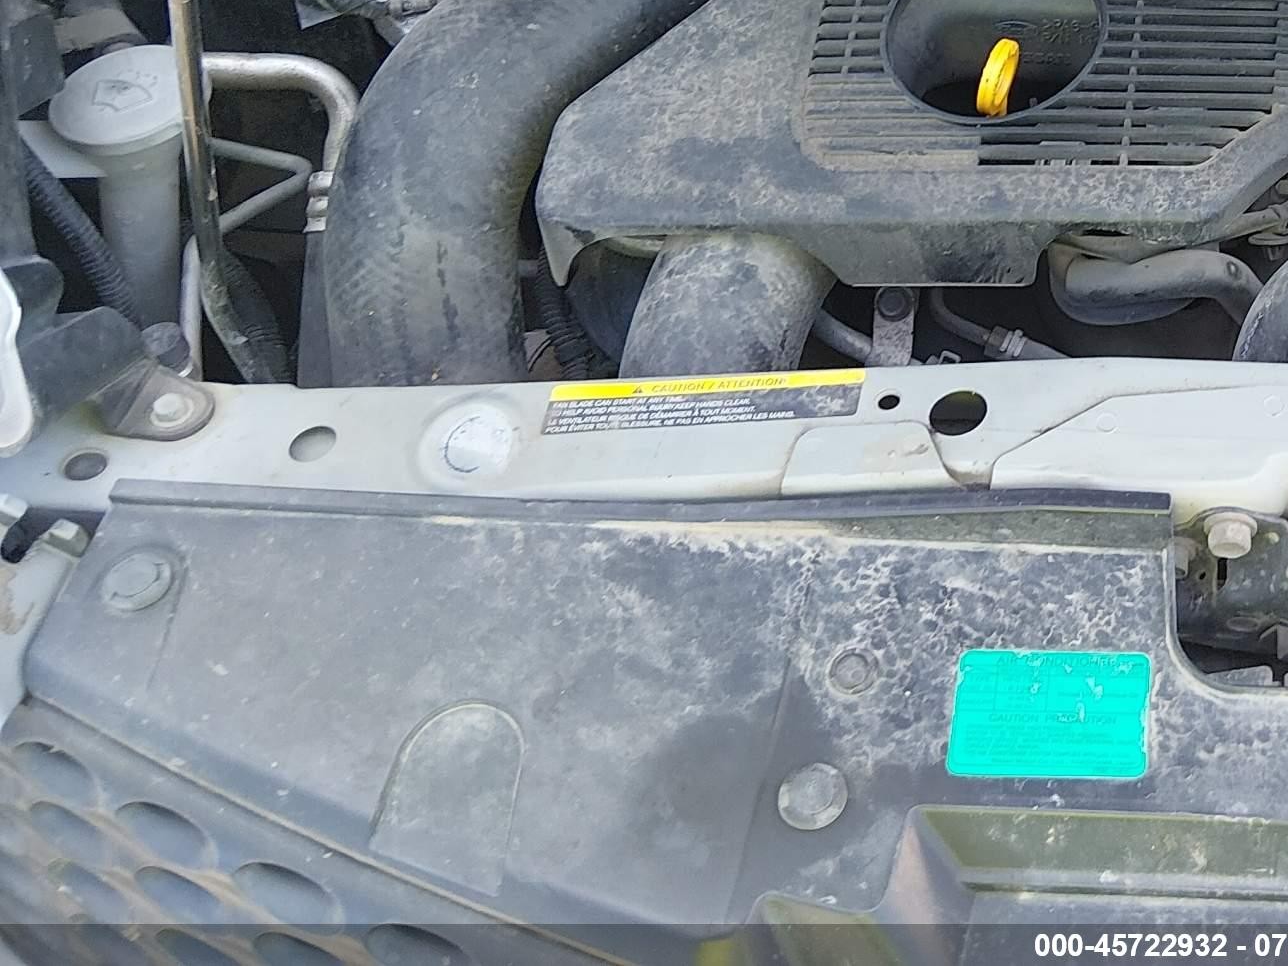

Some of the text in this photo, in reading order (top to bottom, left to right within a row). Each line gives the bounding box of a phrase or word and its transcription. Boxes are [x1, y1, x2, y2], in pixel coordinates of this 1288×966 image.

[651, 382, 704, 393] CAUTION
[561, 408, 583, 417] HELP
[582, 406, 607, 415] AVOID
[606, 405, 649, 415] PERSONAL
[648, 403, 675, 411] INJURY
[674, 402, 696, 410] KEEP
[695, 399, 722, 408] HANDS
[568, 400, 594, 408] BLADE
[612, 398, 637, 406] START
[647, 396, 665, 404] ANY
[559, 415, 608, 425] VENTILATEUR
[649, 410, 693, 419] DÉMARRER
[700, 408, 720, 417] TOUT
[720, 405, 756, 414] MOMENT.
[544, 425, 568, 434] POUR
[663, 418, 675, 426] NE
[675, 417, 693, 426] PAS
[693, 415, 705, 424] EN
[704, 413, 752, 423] APPROCHER
[752, 411, 768, 420] LES
[997, 656, 1016, 666] AIR
[989, 713, 1039, 722] CAUTION
